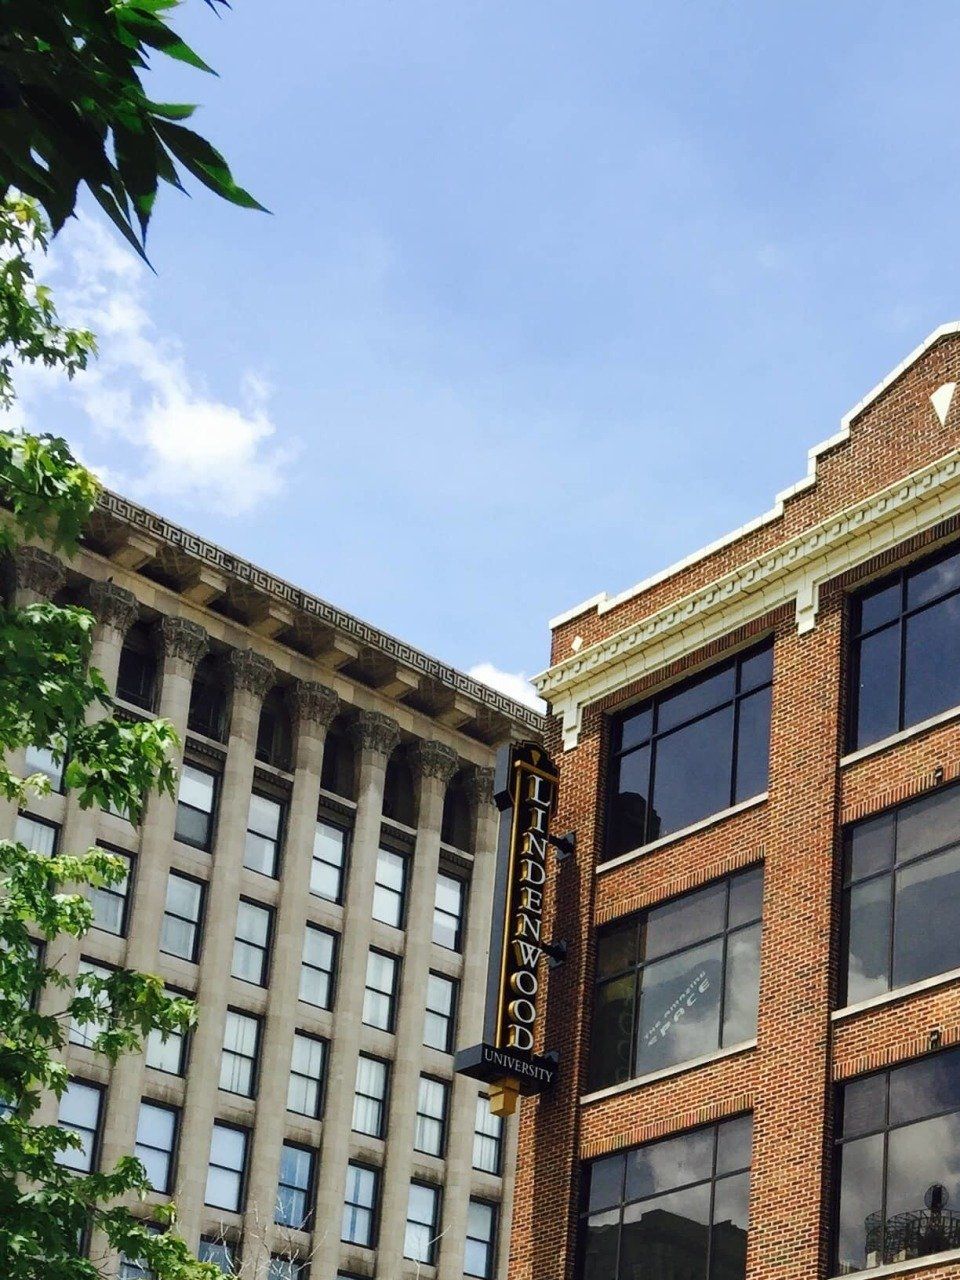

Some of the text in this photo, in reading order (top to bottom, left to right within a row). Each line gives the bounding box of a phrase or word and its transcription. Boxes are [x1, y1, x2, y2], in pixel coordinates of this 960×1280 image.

[507, 774, 551, 1051] LINDENWOOD
[647, 978, 711, 1046] SPACE
[484, 1048, 553, 1083] UNIVERSITY
